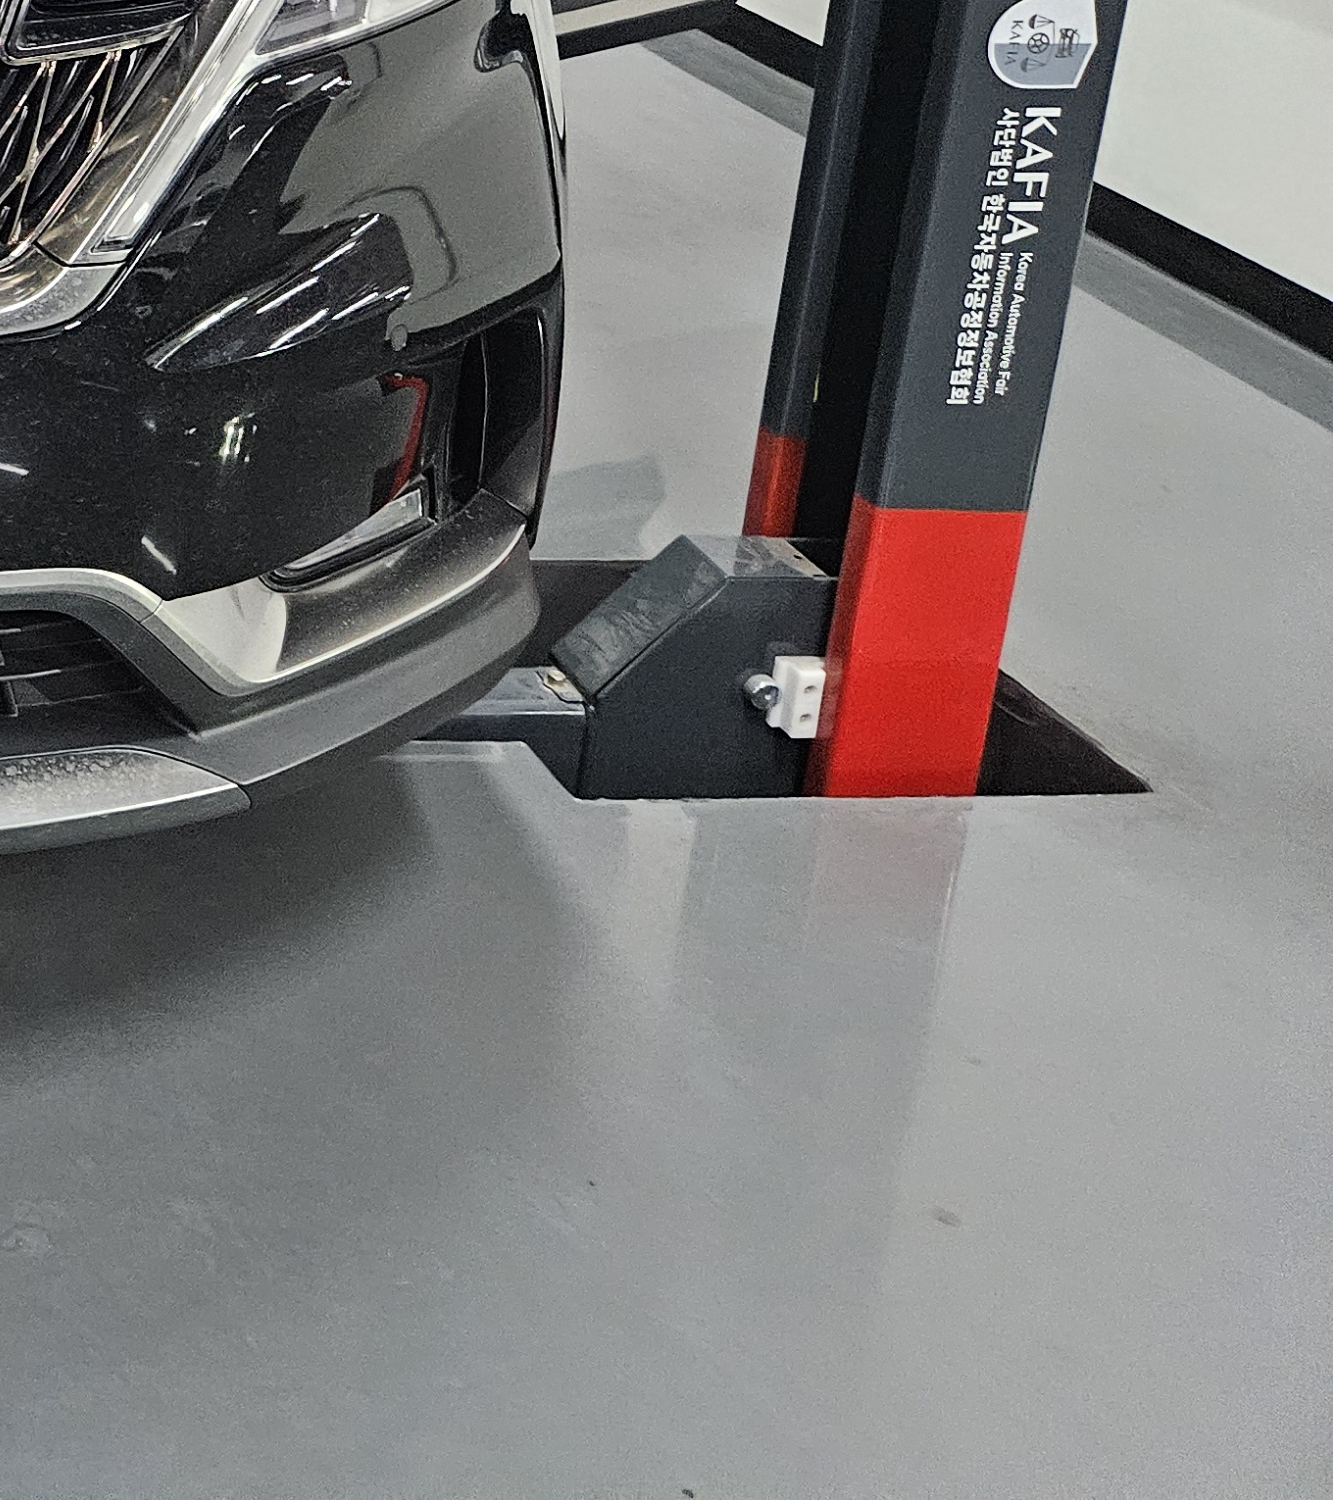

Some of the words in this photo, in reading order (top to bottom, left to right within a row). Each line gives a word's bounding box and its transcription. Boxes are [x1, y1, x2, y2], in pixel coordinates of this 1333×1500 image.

[986, 107, 1021, 187] 사단법인
[1001, 107, 1062, 245] KAFIA
[986, 252, 1014, 328] Information
[1013, 252, 1034, 291] Korea
[972, 329, 999, 405] Association
[999, 293, 1026, 369] Automotive
[994, 371, 1012, 396] Fair
